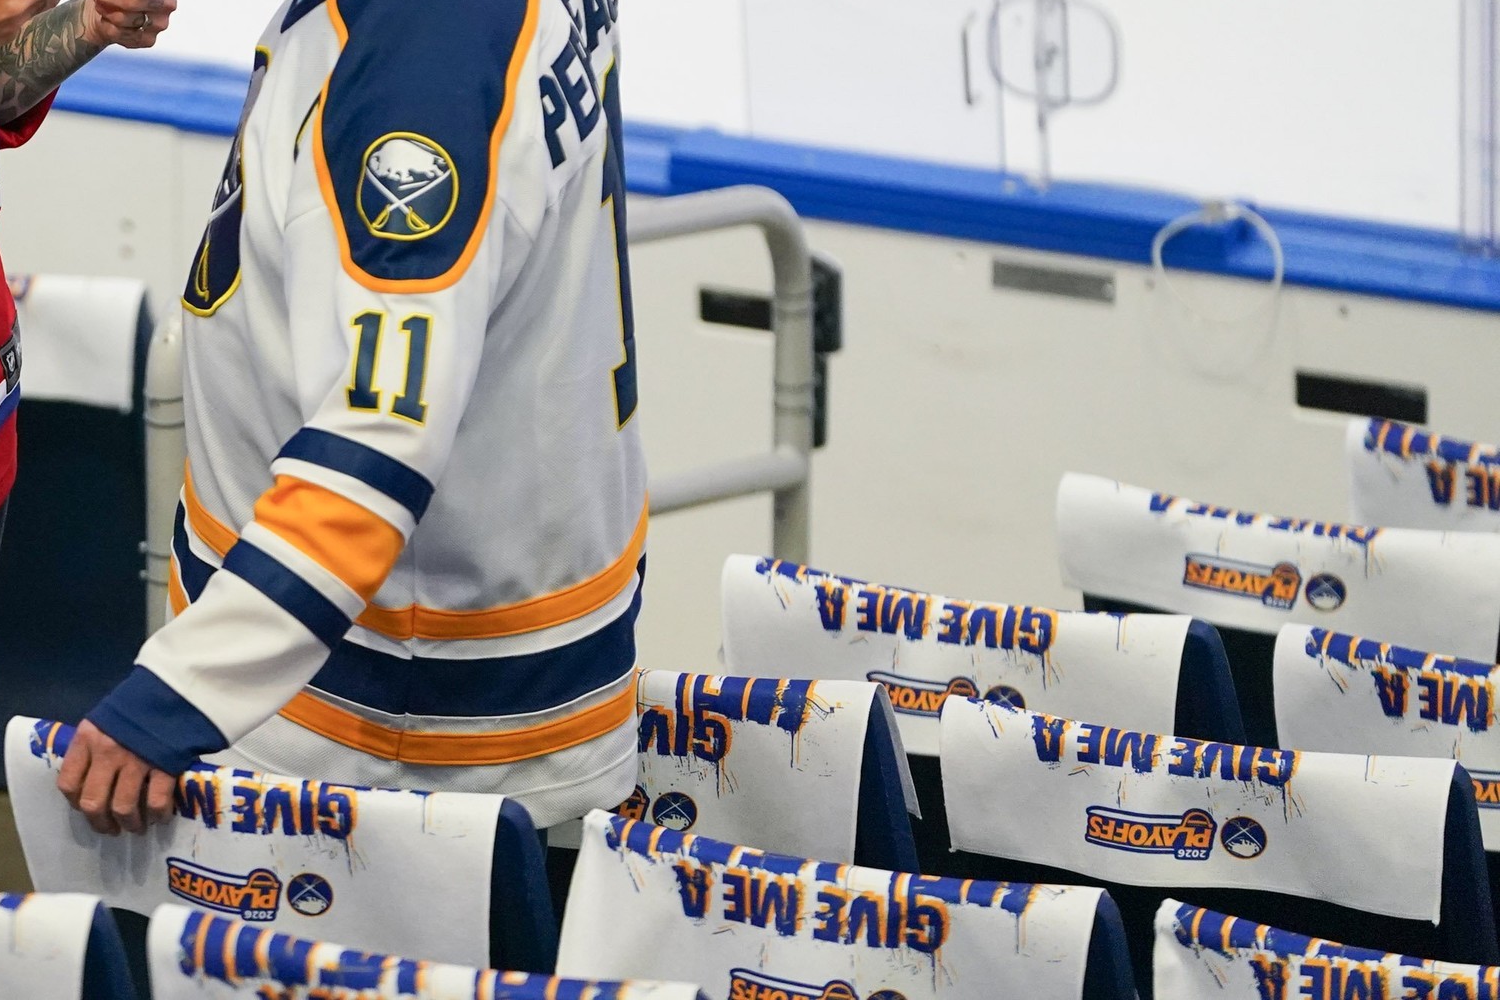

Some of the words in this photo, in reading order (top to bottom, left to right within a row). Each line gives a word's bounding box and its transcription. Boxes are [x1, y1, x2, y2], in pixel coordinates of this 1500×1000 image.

[345, 309, 434, 427] 11
[815, 580, 851, 634] A
[1187, 562, 1299, 602] PLAYOFFS
[856, 586, 933, 641] ME
[937, 601, 1058, 655] GIVE
[1371, 666, 1411, 718] A
[1417, 670, 1494, 733] ME
[638, 698, 732, 763] GIV
[1032, 713, 1068, 764] A
[1077, 723, 1162, 773] ME
[1167, 736, 1302, 787] GIVE
[176, 770, 222, 830] M
[231, 776, 360, 839] GIVE
[1088, 814, 1212, 850] PLAYOFFS
[1177, 848, 1208, 858] 2026
[168, 865, 278, 911] PLAYOFFS
[243, 908, 274, 921] 2026
[672, 858, 713, 919] A
[723, 868, 805, 937] ME
[813, 890, 952, 953] GIVE
